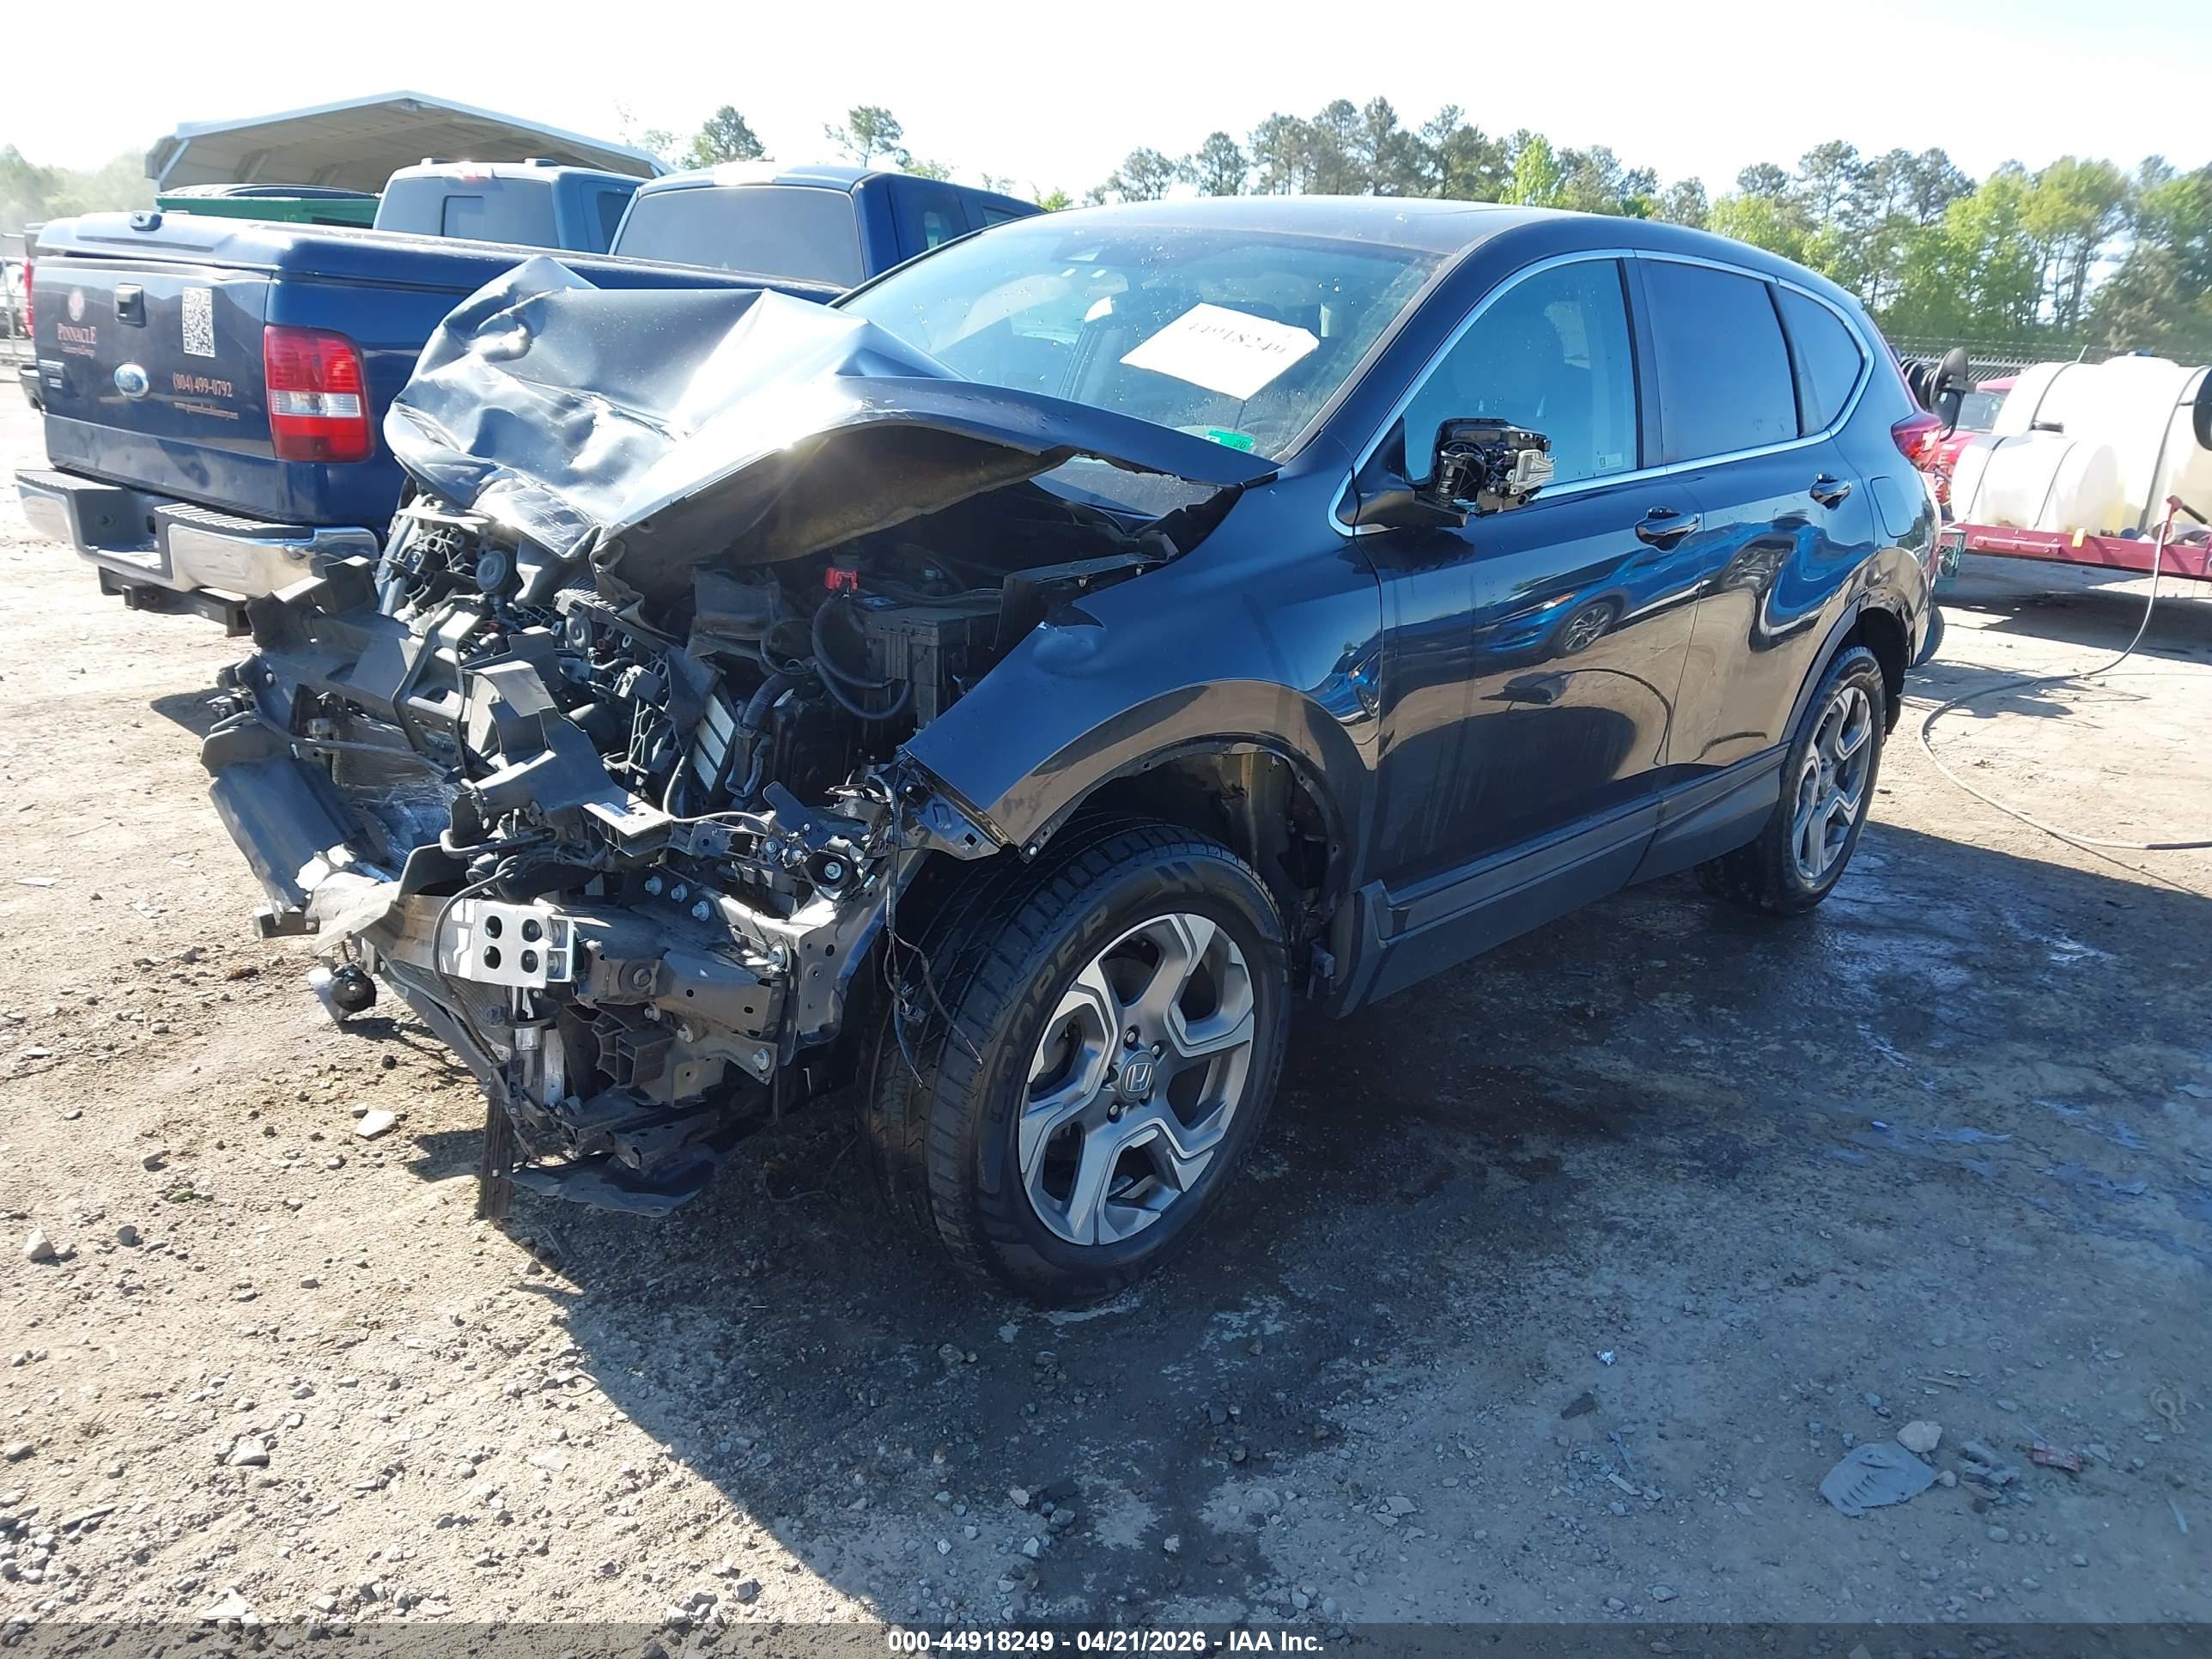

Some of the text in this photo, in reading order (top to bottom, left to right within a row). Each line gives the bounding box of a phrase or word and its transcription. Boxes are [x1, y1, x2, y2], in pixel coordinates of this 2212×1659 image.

[57, 323, 97, 344] PINNACLE
[173, 372, 233, 398] (804) 499-0792
